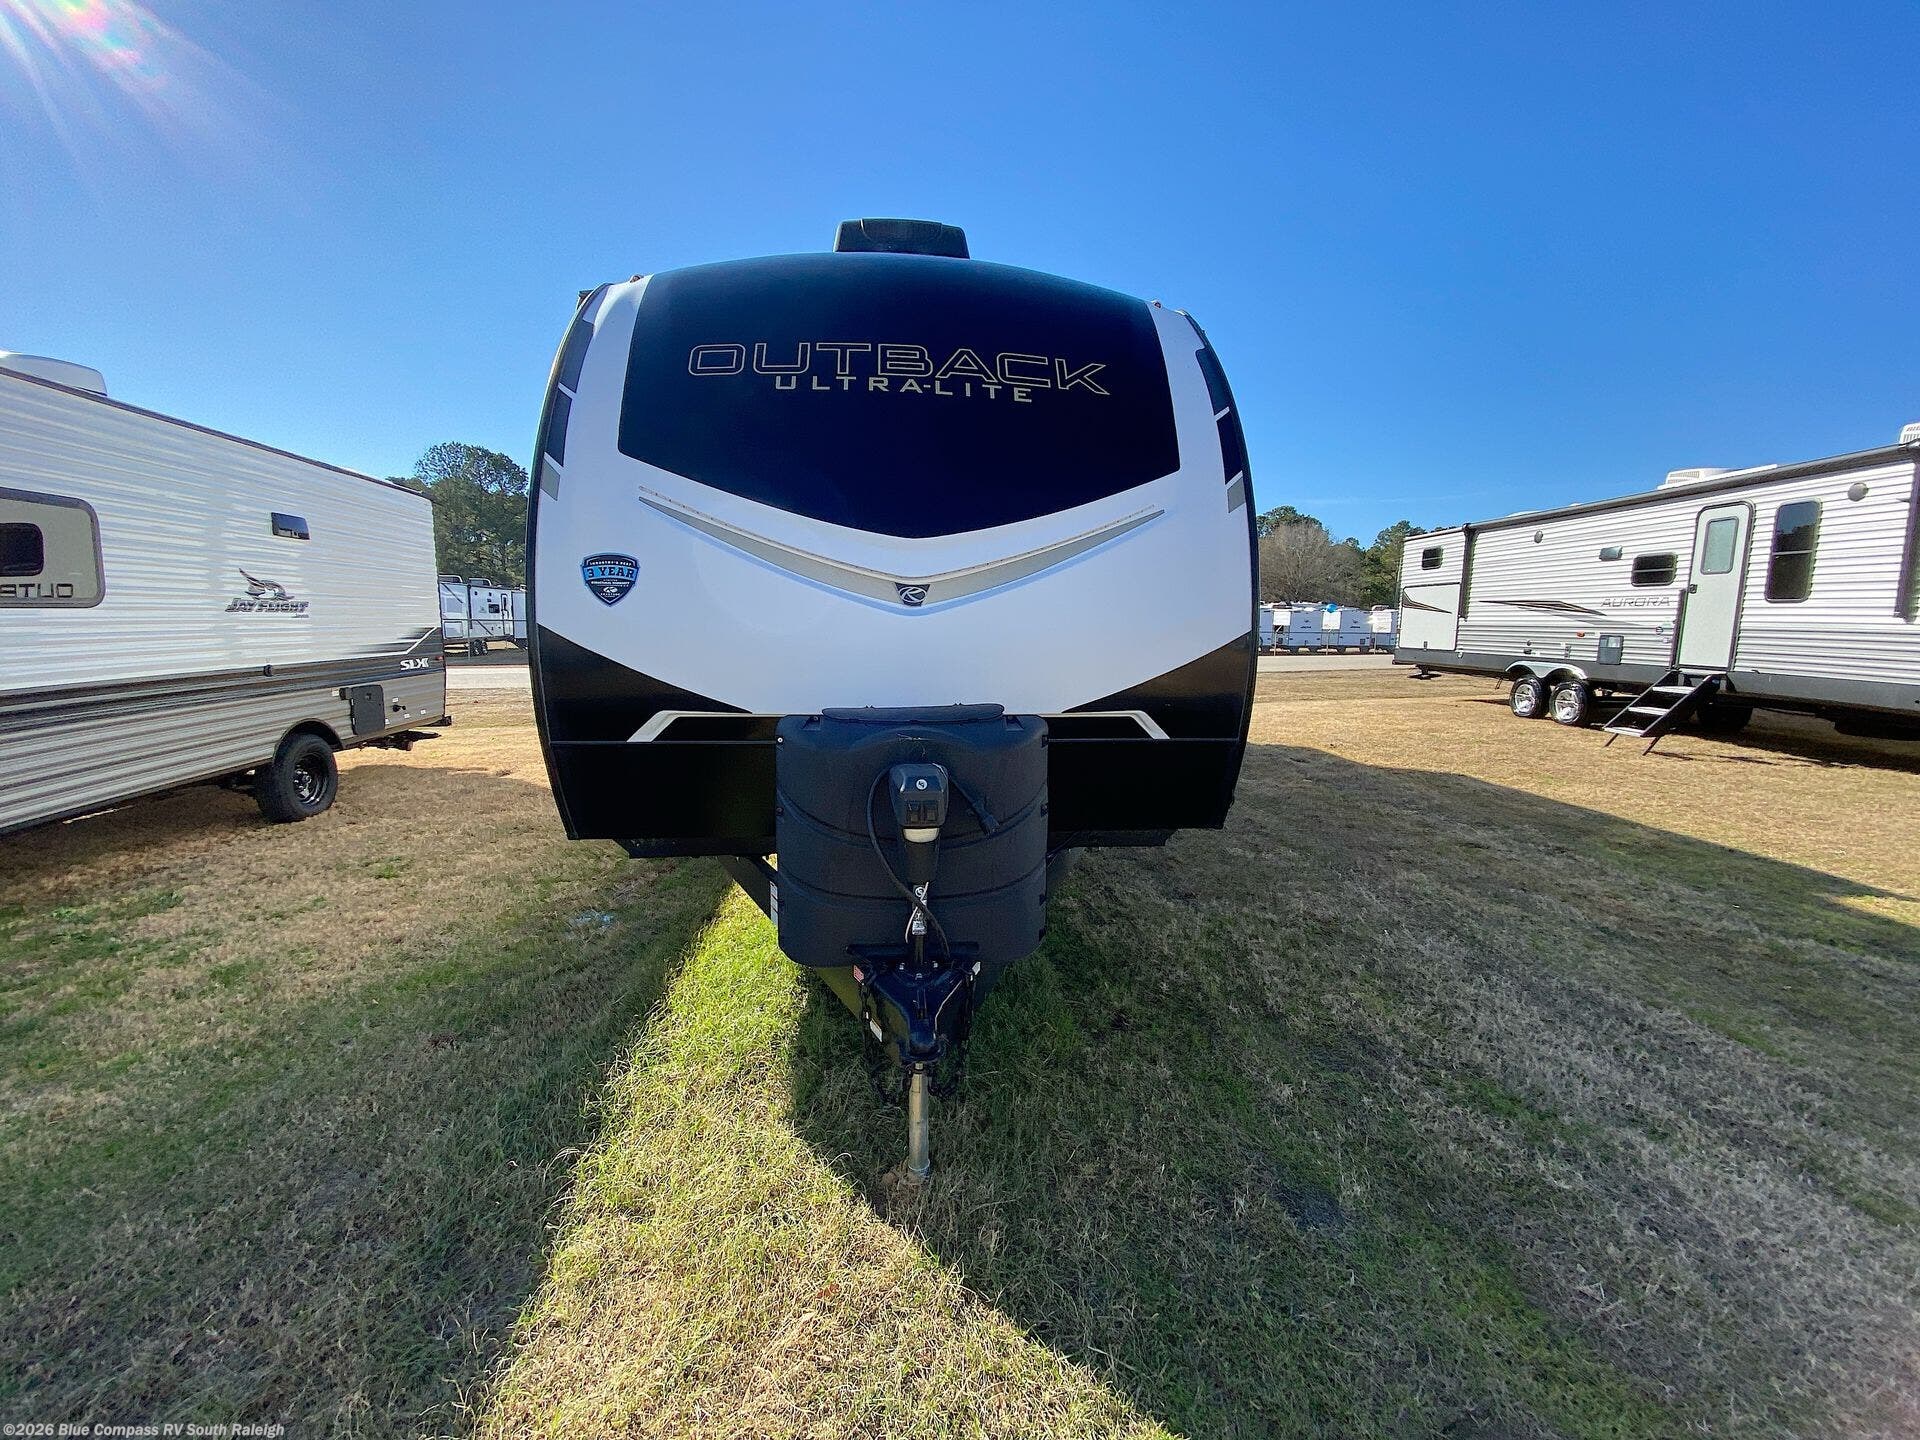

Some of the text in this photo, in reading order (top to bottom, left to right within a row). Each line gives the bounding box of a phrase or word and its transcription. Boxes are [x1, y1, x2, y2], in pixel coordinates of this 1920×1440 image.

[688, 342, 1110, 395] OUTBACK
[775, 375, 1032, 403] ULTRA-LITE
[587, 567, 635, 578] 3 YEAR
[225, 598, 309, 613] JAY FLIGHT
[1601, 596, 1670, 607] AURORA
